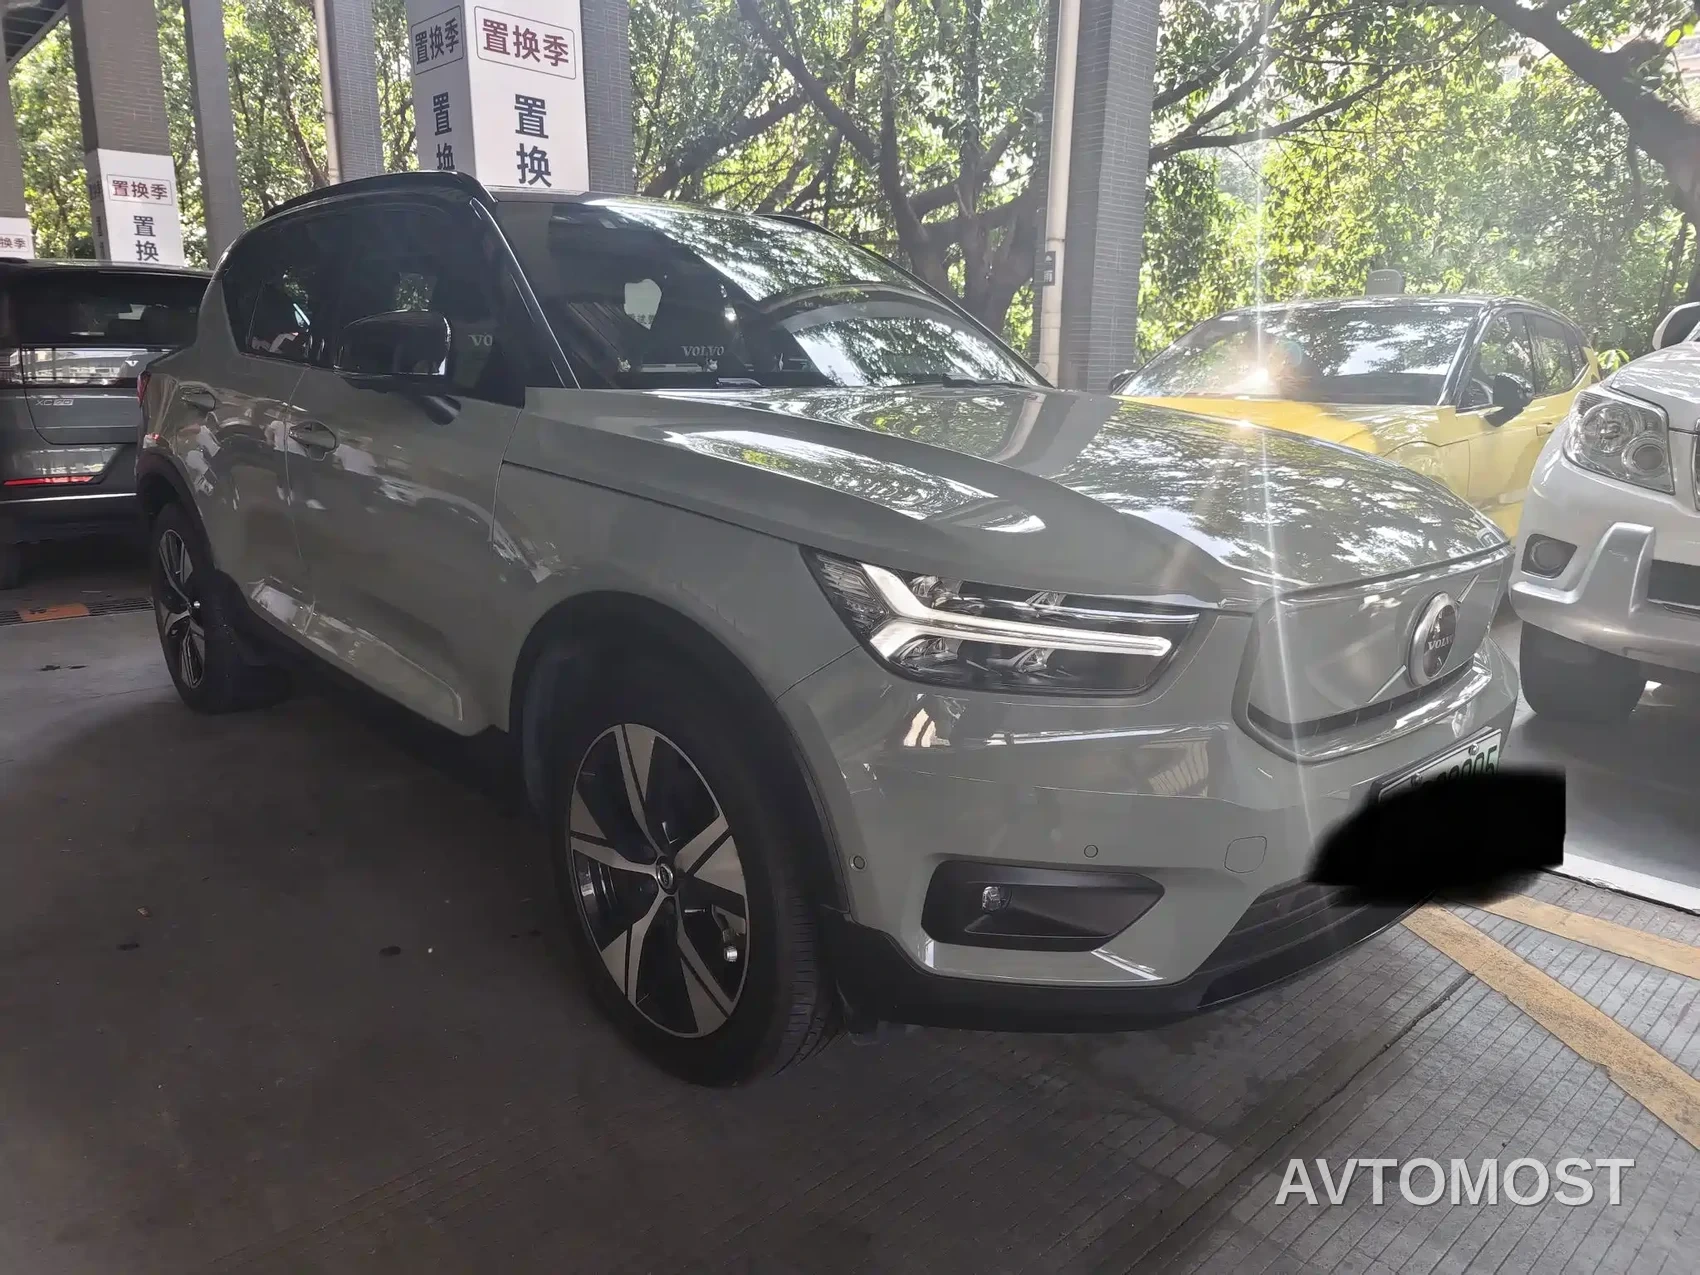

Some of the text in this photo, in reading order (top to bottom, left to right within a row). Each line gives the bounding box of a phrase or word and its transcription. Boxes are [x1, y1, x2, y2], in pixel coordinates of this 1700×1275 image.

[414, 18, 460, 66] 置换季
[482, 18, 570, 68] 置换季
[514, 93, 552, 188] 置换
[112, 179, 169, 201] 置换季
[133, 215, 160, 262] 置换
[681, 345, 725, 357] VOLVO
